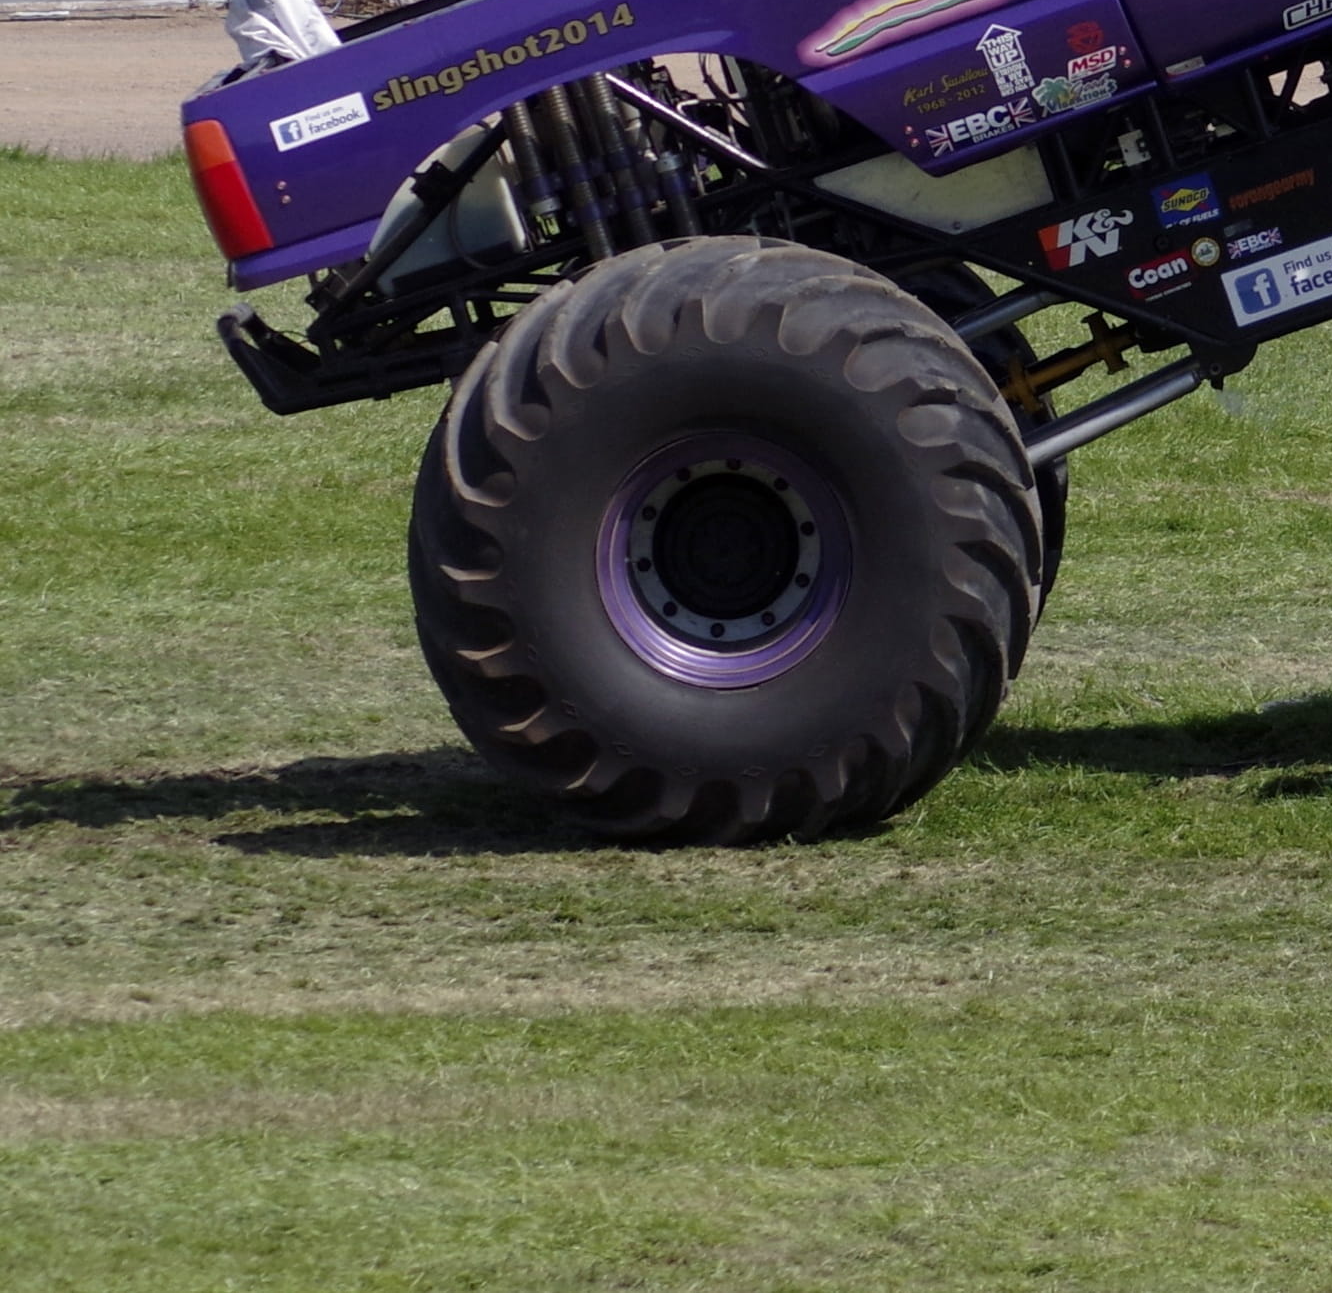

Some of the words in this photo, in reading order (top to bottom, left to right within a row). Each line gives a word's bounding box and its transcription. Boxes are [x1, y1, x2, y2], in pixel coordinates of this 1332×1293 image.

[983, 32, 1014, 48] THIS
[988, 42, 1014, 56] WAY
[373, 3, 636, 111] slingshot2014
[991, 49, 1018, 67] UP
[1072, 49, 1114, 74] MSD
[956, 84, 986, 101] 2012
[308, 108, 360, 135] facebook
[947, 105, 1011, 143] EBC
[972, 123, 1016, 144] BRAKES
[1162, 187, 1210, 211] SUNOCO
[1193, 208, 1220, 223] FUELS
[1056, 208, 1134, 267] K&N
[1238, 231, 1271, 252] EBC
[1128, 257, 1189, 289] Coan
[1283, 255, 1313, 275] Find
[1315, 251, 1332, 263] us
